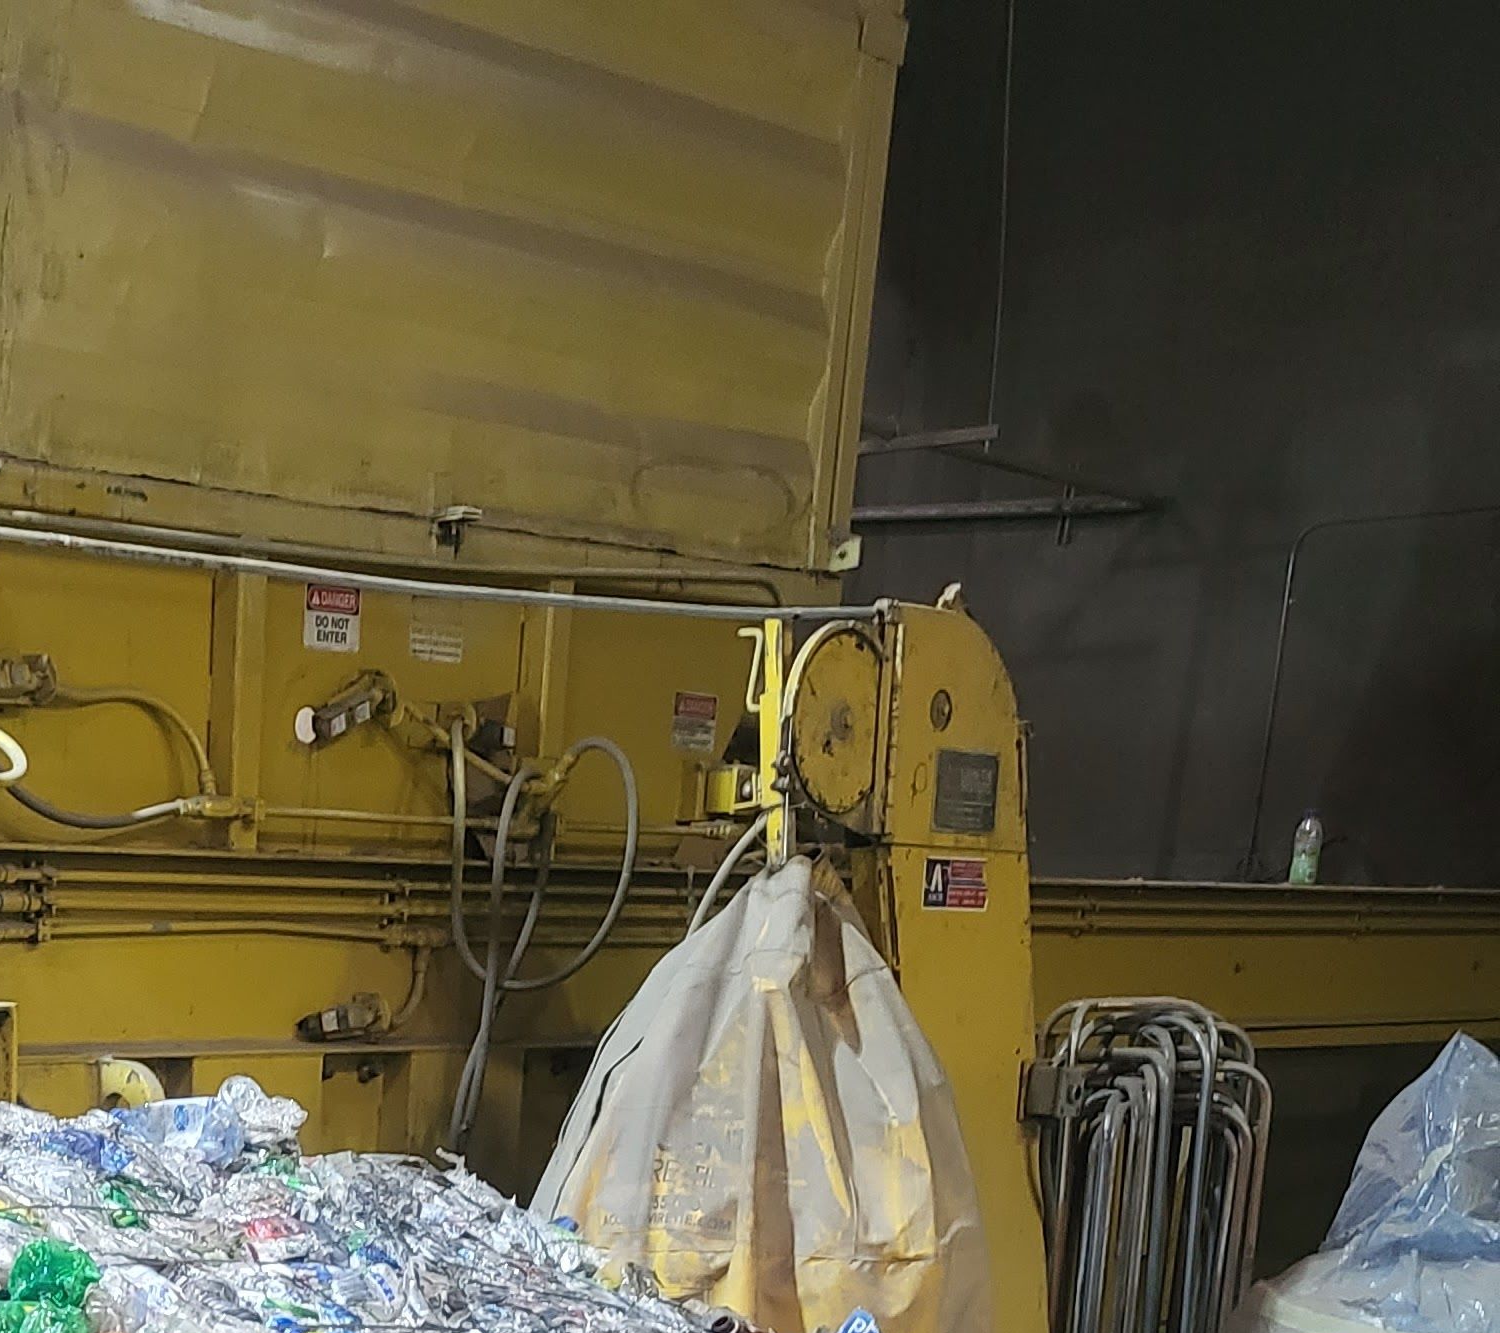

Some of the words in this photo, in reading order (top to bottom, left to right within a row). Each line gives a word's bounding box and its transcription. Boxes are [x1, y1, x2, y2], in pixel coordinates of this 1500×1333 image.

[321, 591, 356, 608] DANGER
[315, 615, 329, 628] DO
[331, 616, 351, 631] NOT
[316, 628, 347, 644] ENTER
